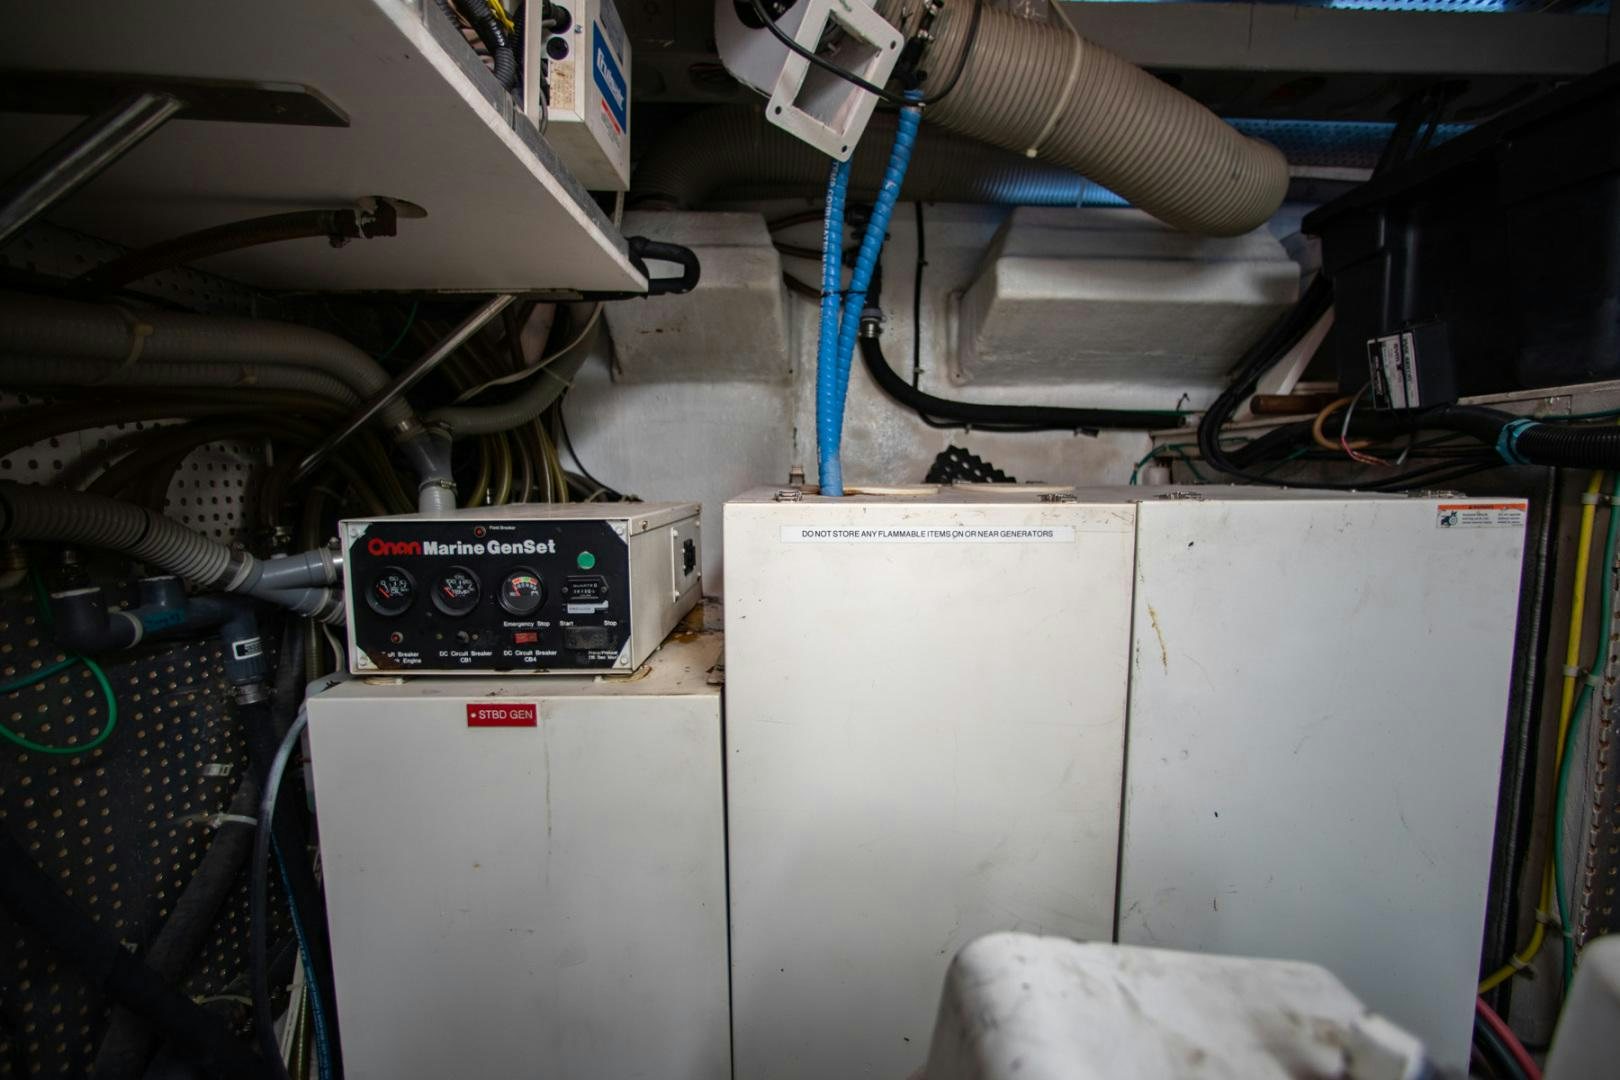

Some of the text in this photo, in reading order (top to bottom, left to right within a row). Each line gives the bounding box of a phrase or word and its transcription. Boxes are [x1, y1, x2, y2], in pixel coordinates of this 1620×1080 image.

[802, 530, 1054, 538] DO NOT STORE ANY FLAMMABLE ITEMS ON OR NEAR GENERATORS
[368, 538, 556, 556] Onan Marine GenSet
[537, 620, 551, 628] Stop
[479, 709, 533, 720] STBD GEN
